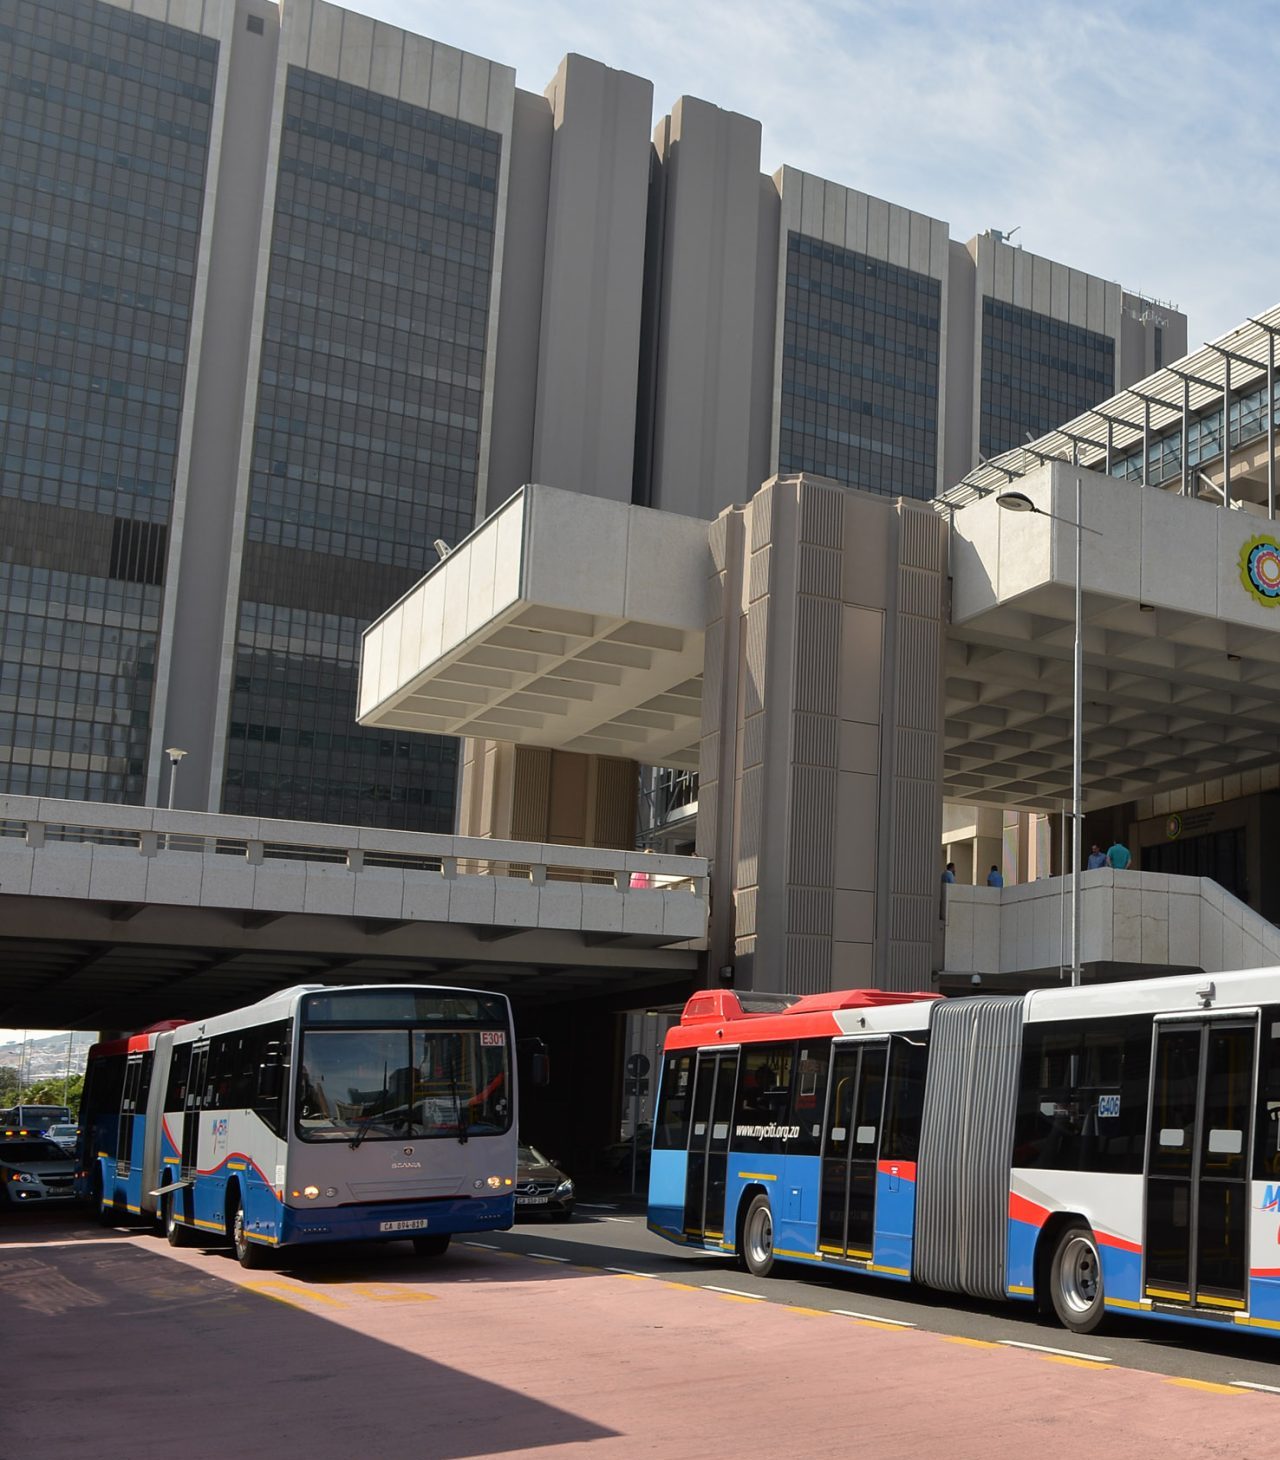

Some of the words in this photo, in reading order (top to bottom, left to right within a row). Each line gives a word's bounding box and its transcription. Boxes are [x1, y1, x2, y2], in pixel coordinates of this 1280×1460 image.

[482, 1032, 504, 1045] E301
[1100, 1096, 1120, 1116] G406
[735, 1122, 800, 1142] www.myciti.org.za
[384, 1222, 393, 1231] CA
